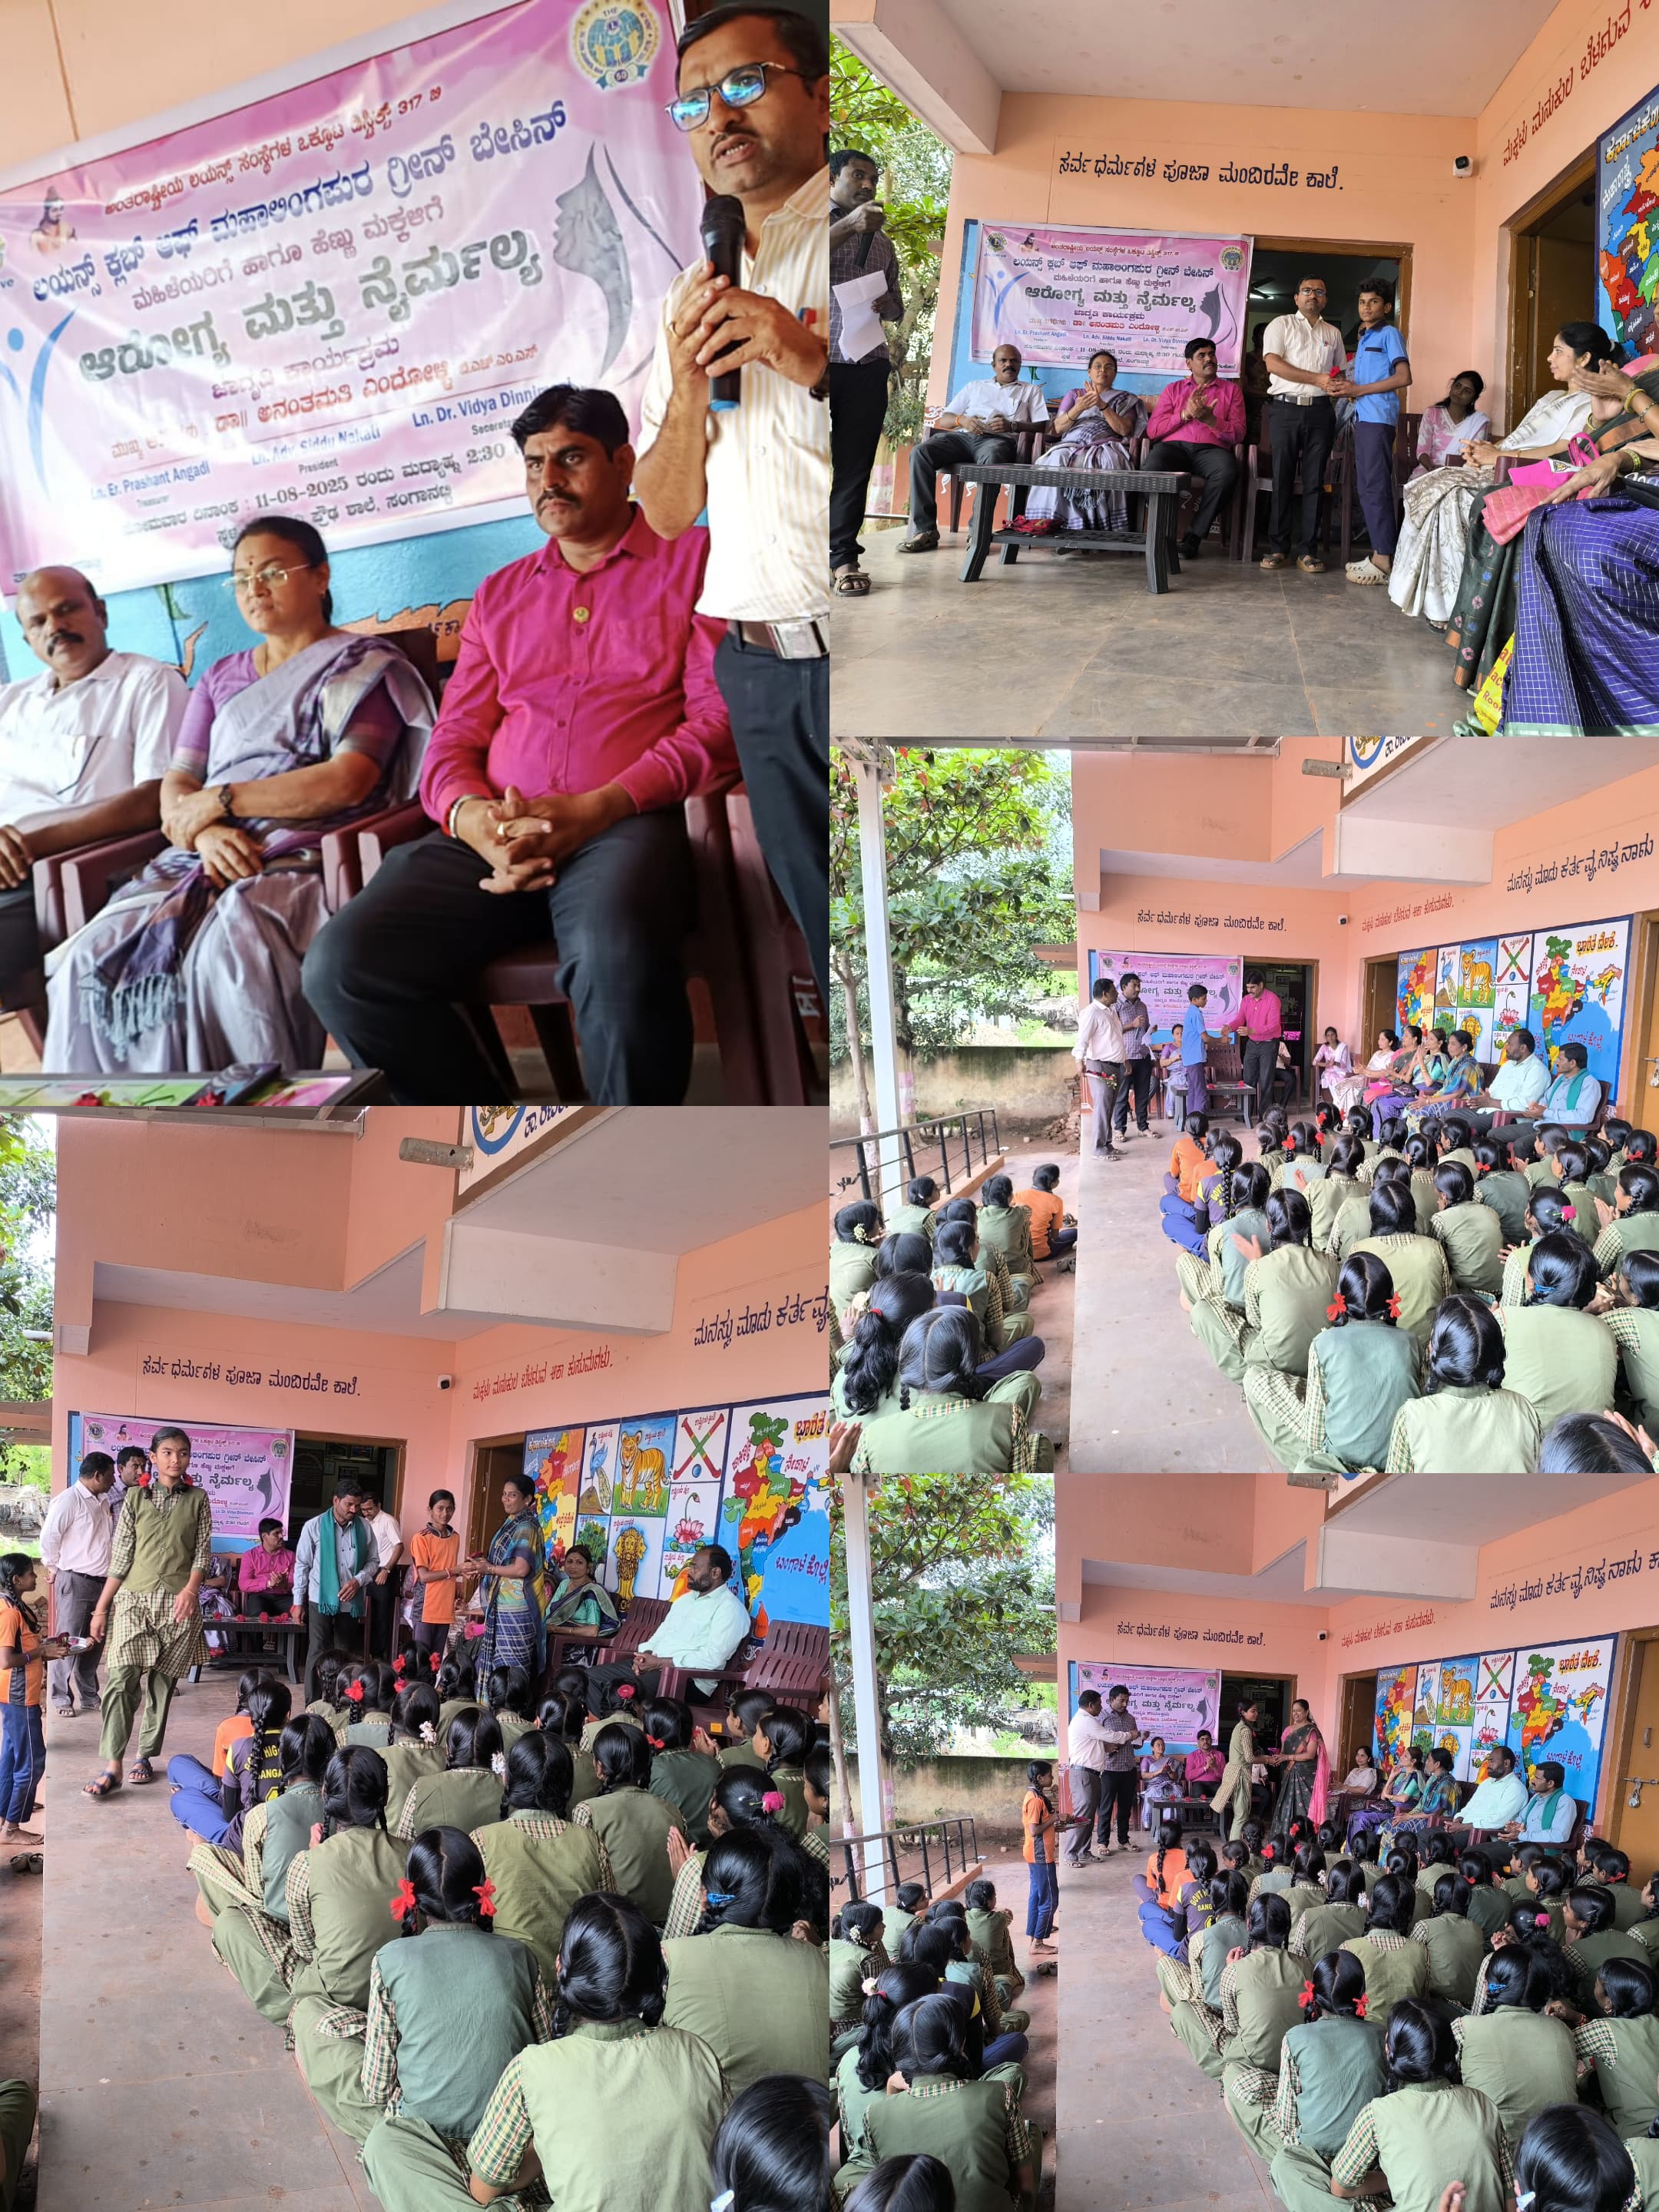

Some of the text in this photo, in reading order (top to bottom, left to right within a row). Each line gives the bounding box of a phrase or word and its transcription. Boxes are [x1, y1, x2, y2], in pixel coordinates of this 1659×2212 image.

[398, 93, 423, 115] 317
[210, 159, 373, 242] ಮಹಾಲಿಂಗಪುರ
[387, 134, 455, 199] ಗ್ರೀನ್
[470, 100, 567, 162] ಬೇಸಿನ್
[1163, 159, 1210, 183] ಪೂಜಾ
[1218, 161, 1299, 187] ಮಂದಿರವೇ
[243, 241, 303, 276] ಹಾಗೂ
[363, 195, 445, 243] ಮಕ್ಕಳಿಗೆ
[79, 230, 543, 381] ಆರೋಗ್ಯ ಮತ್ತು ನೈರ್ಮಲ್ಯ
[1025, 285, 1197, 313] ಆರೋಗ್ಯ ಮತ್ತು ನೈರ್ಮಲ್ಯ
[435, 406, 457, 422] Dr.
[458, 396, 498, 419] Vidya
[123, 470, 171, 494] Prashant
[172, 460, 210, 482] Angadi
[255, 475, 349, 509] 11-08-2025
[466, 442, 505, 465] 2:30
[226, 1366, 262, 1385] ಪೂಜಾ
[269, 1369, 329, 1392] ಮಂದಿರವೇ
[263, 1744, 280, 1758] HIG
[258, 1768, 283, 1780] ANGA
[1197, 1903, 1213, 1912] SANG
